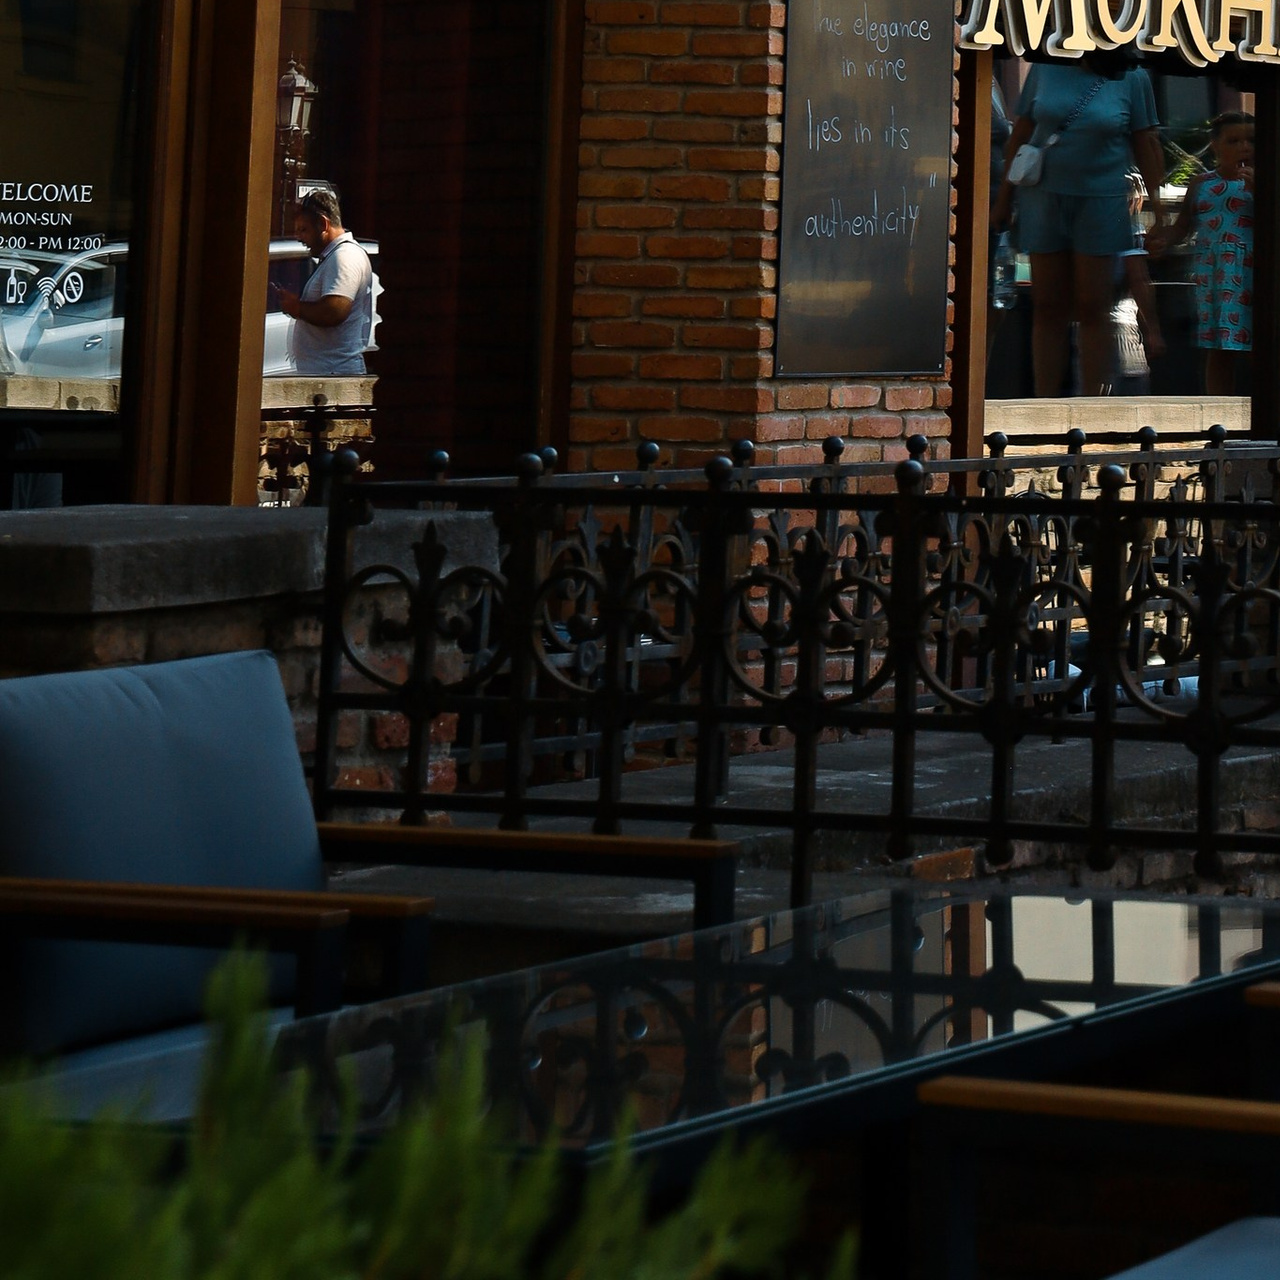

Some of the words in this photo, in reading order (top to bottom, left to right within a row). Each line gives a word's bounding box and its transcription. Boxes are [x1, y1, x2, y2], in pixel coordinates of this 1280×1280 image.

[853, 1, 932, 53] elegance
[842, 56, 857, 78] in
[866, 57, 907, 82] wine
[807, 99, 842, 151] lies
[855, 120, 872, 144] in
[885, 105, 911, 150] its
[0, 182, 93, 203] ELCOME
[0, 211, 72, 226] MON-SUN
[0, 236, 26, 250] 2:00
[39, 237, 63, 250] PM
[67, 237, 102, 250] 12:00
